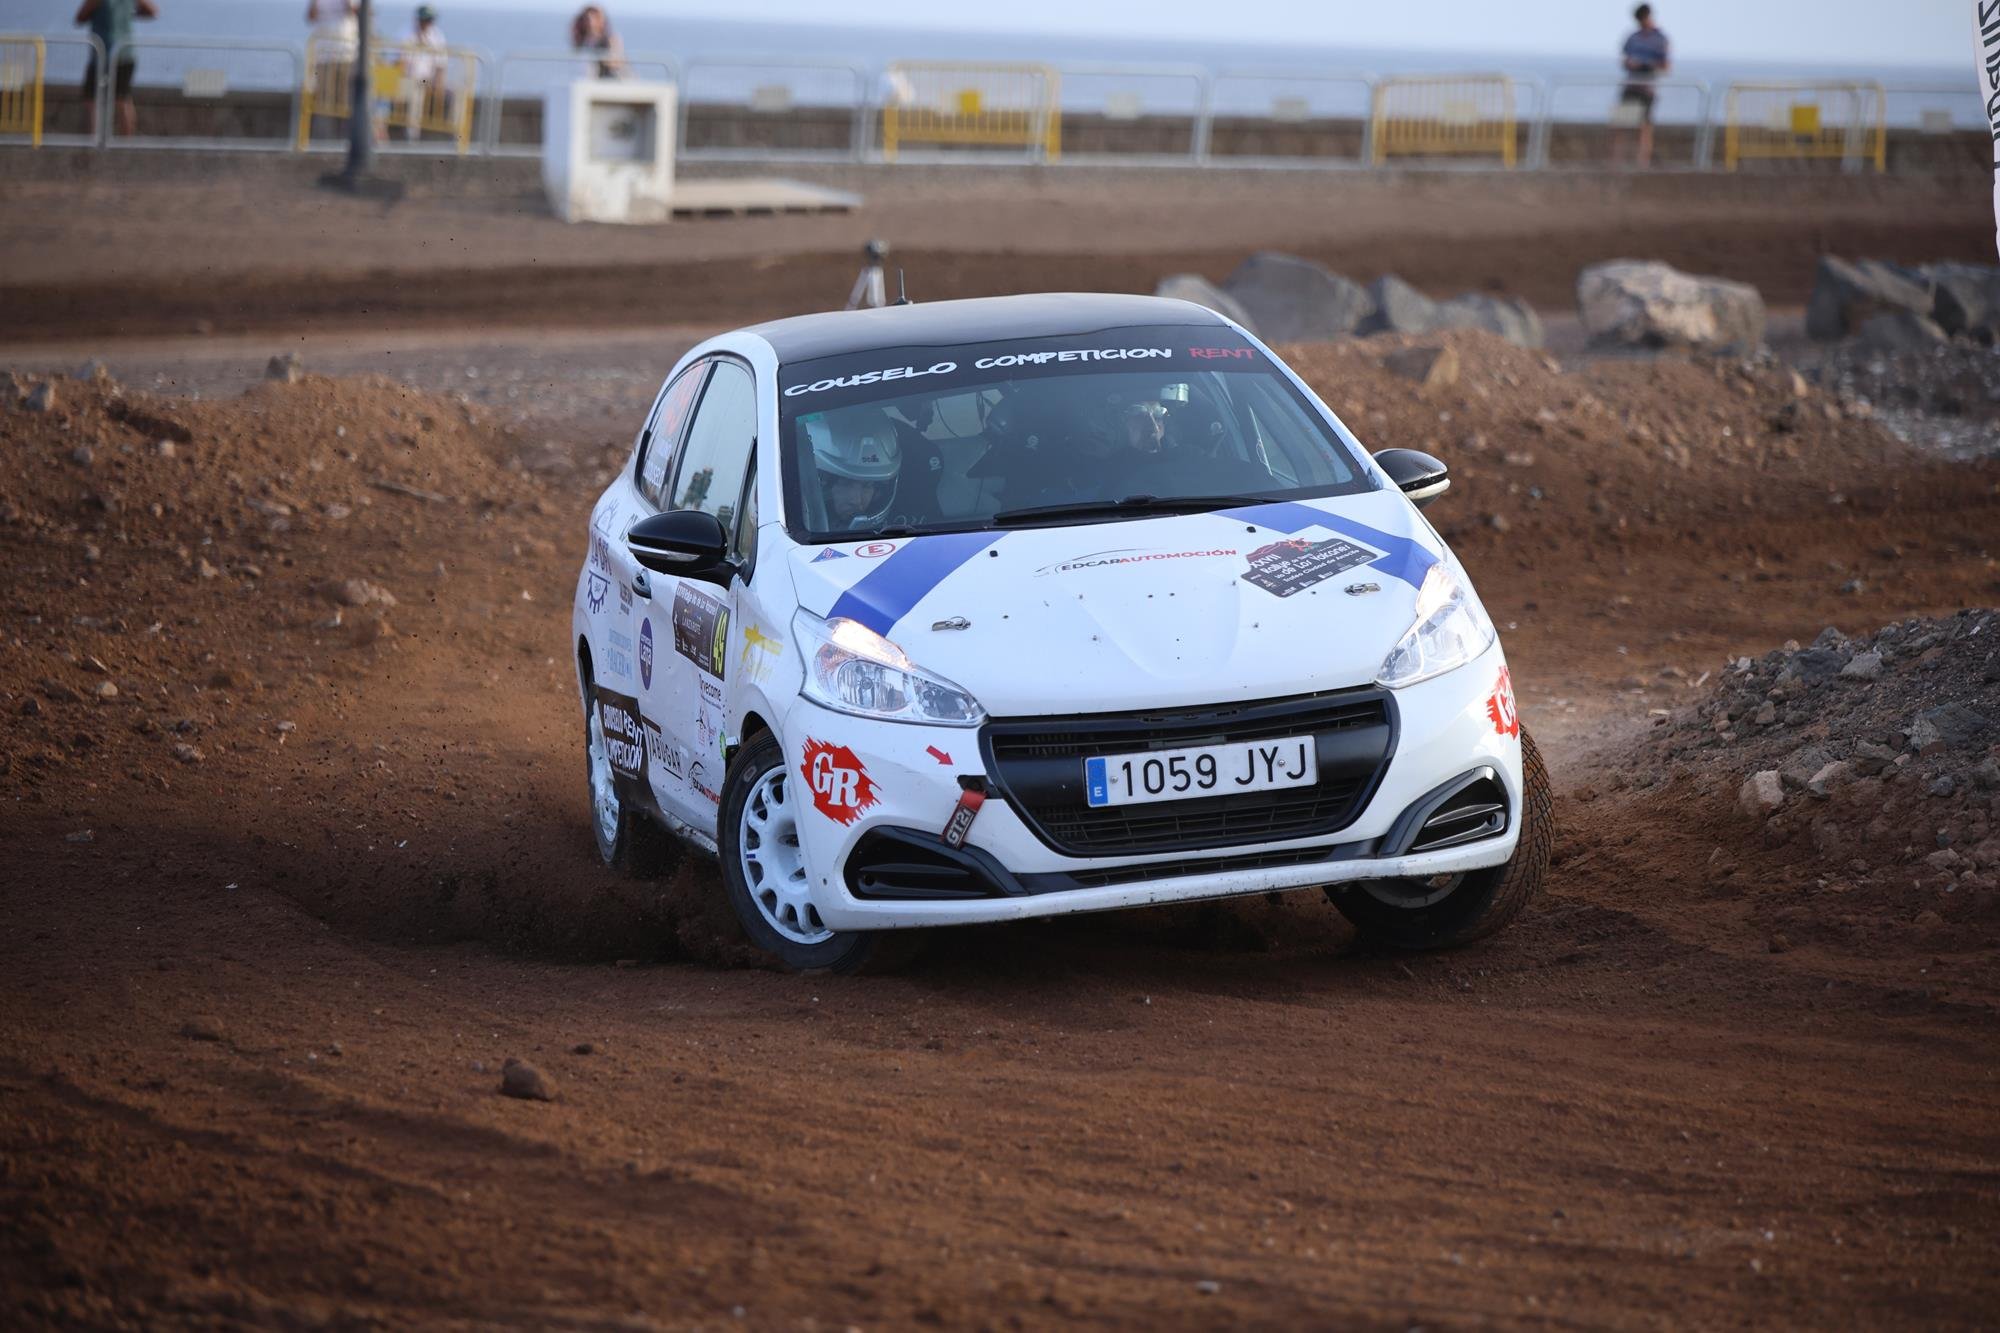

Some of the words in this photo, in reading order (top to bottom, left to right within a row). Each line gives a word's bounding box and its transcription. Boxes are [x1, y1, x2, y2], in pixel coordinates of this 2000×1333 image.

[784, 361, 958, 398] COUSELO
[974, 347, 1172, 370] COMPETICION
[1188, 346, 1255, 361] RENT
[868, 544, 884, 553] E
[1250, 553, 1281, 569] XXVII
[1296, 559, 1313, 570] Los
[1313, 545, 1351, 561] Volcanes
[624, 710, 644, 743] RENT
[812, 752, 861, 809] GR
[1121, 753, 1217, 797] 1059
[1234, 743, 1305, 786] JYJ
[1094, 787, 1103, 797] E
